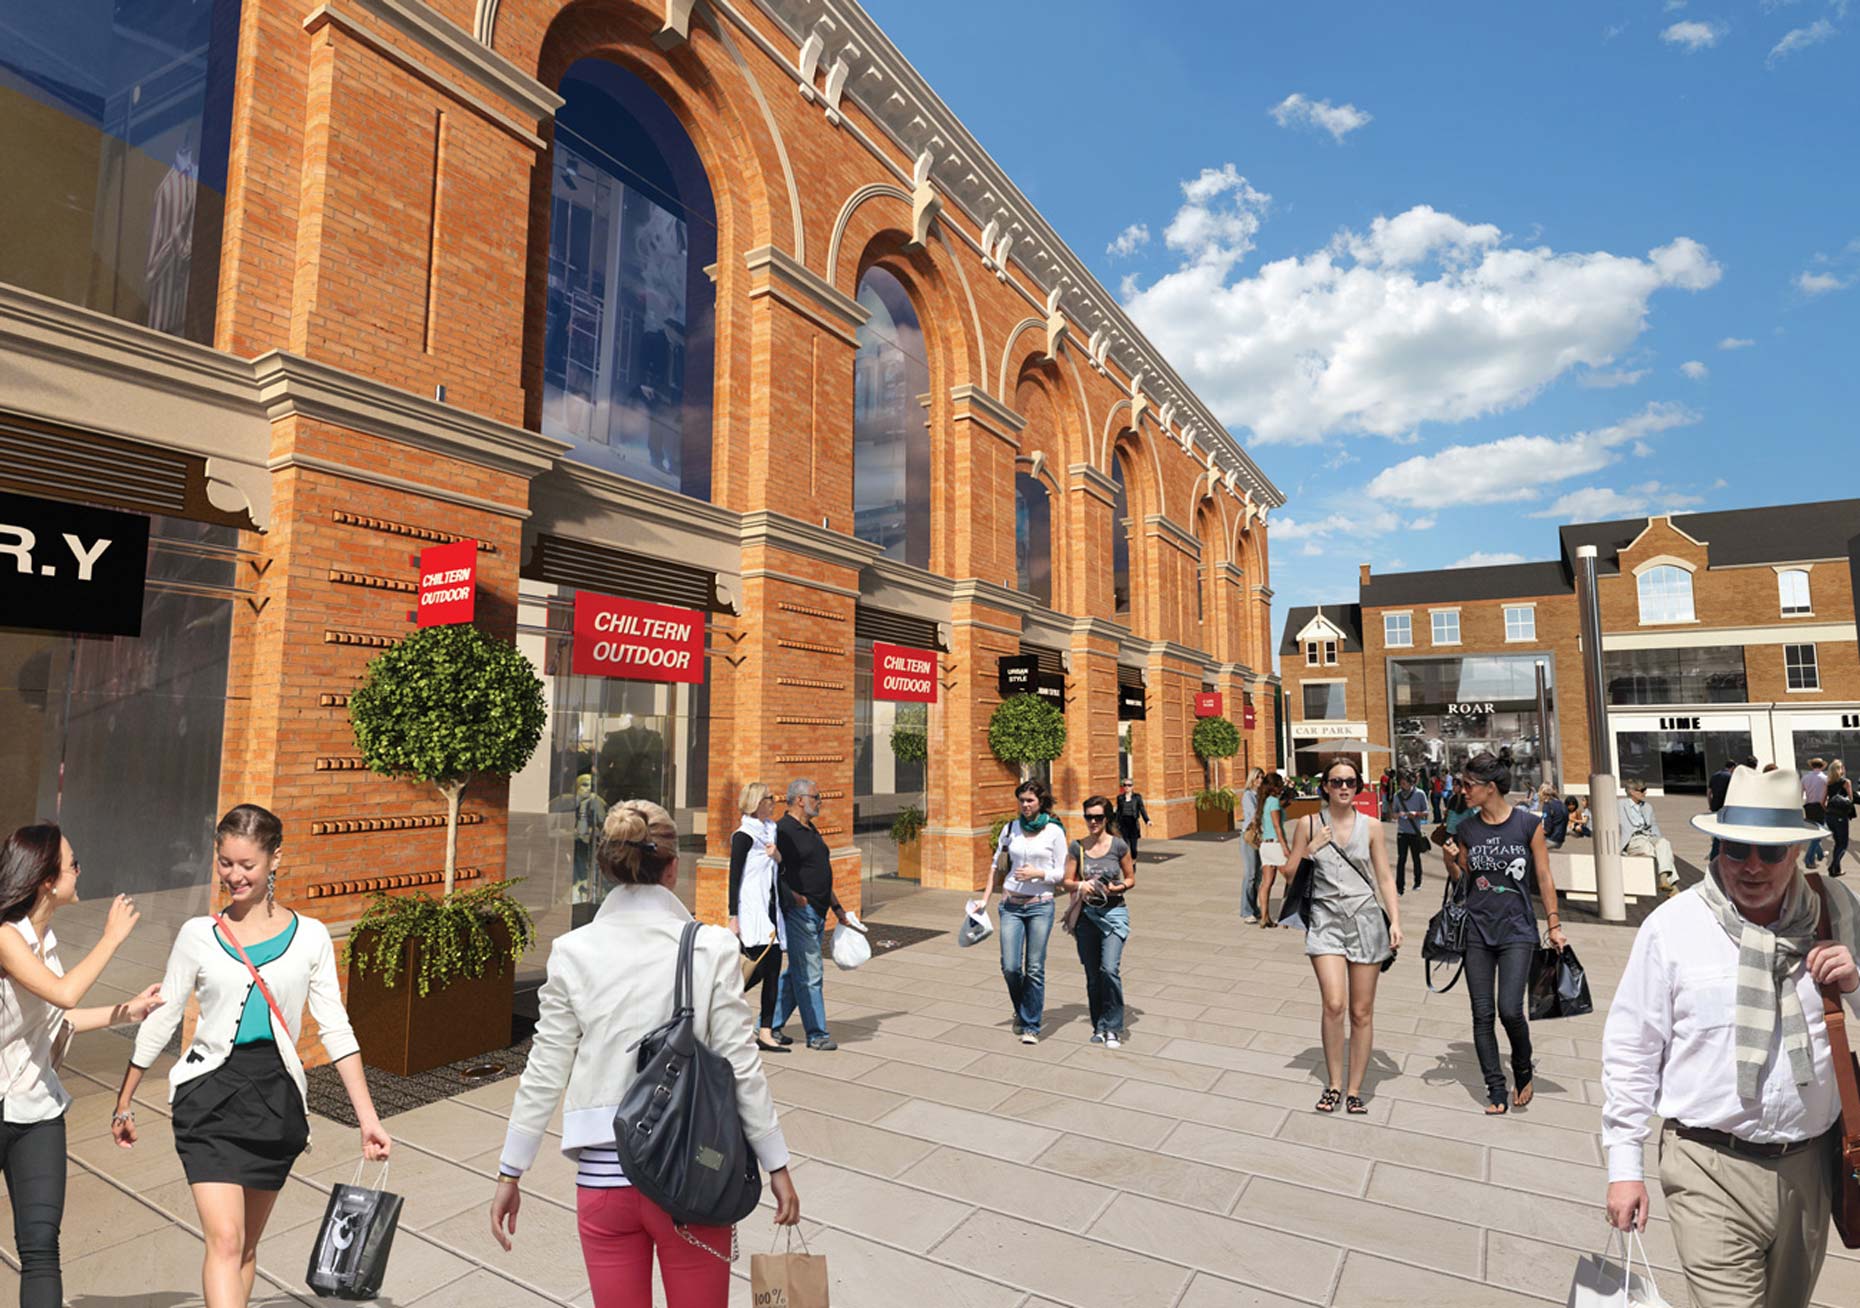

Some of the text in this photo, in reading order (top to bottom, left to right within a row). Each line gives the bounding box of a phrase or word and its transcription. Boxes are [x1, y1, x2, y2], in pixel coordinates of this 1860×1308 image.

[422, 567, 471, 588] CHILTERN
[421, 586, 470, 606] OUTDOOR
[594, 611, 691, 642] CHILTERN
[592, 641, 690, 669] OUTDOOR
[883, 655, 931, 674] CHILTERN
[883, 675, 931, 694] OUTDOOR
[1008, 675, 1028, 683] STYLE
[1448, 703, 1496, 714] ROAR
[1295, 726, 1353, 735] CAR PARK
[1660, 717, 1701, 730] LIME
[754, 1288, 786, 1306] 100%
